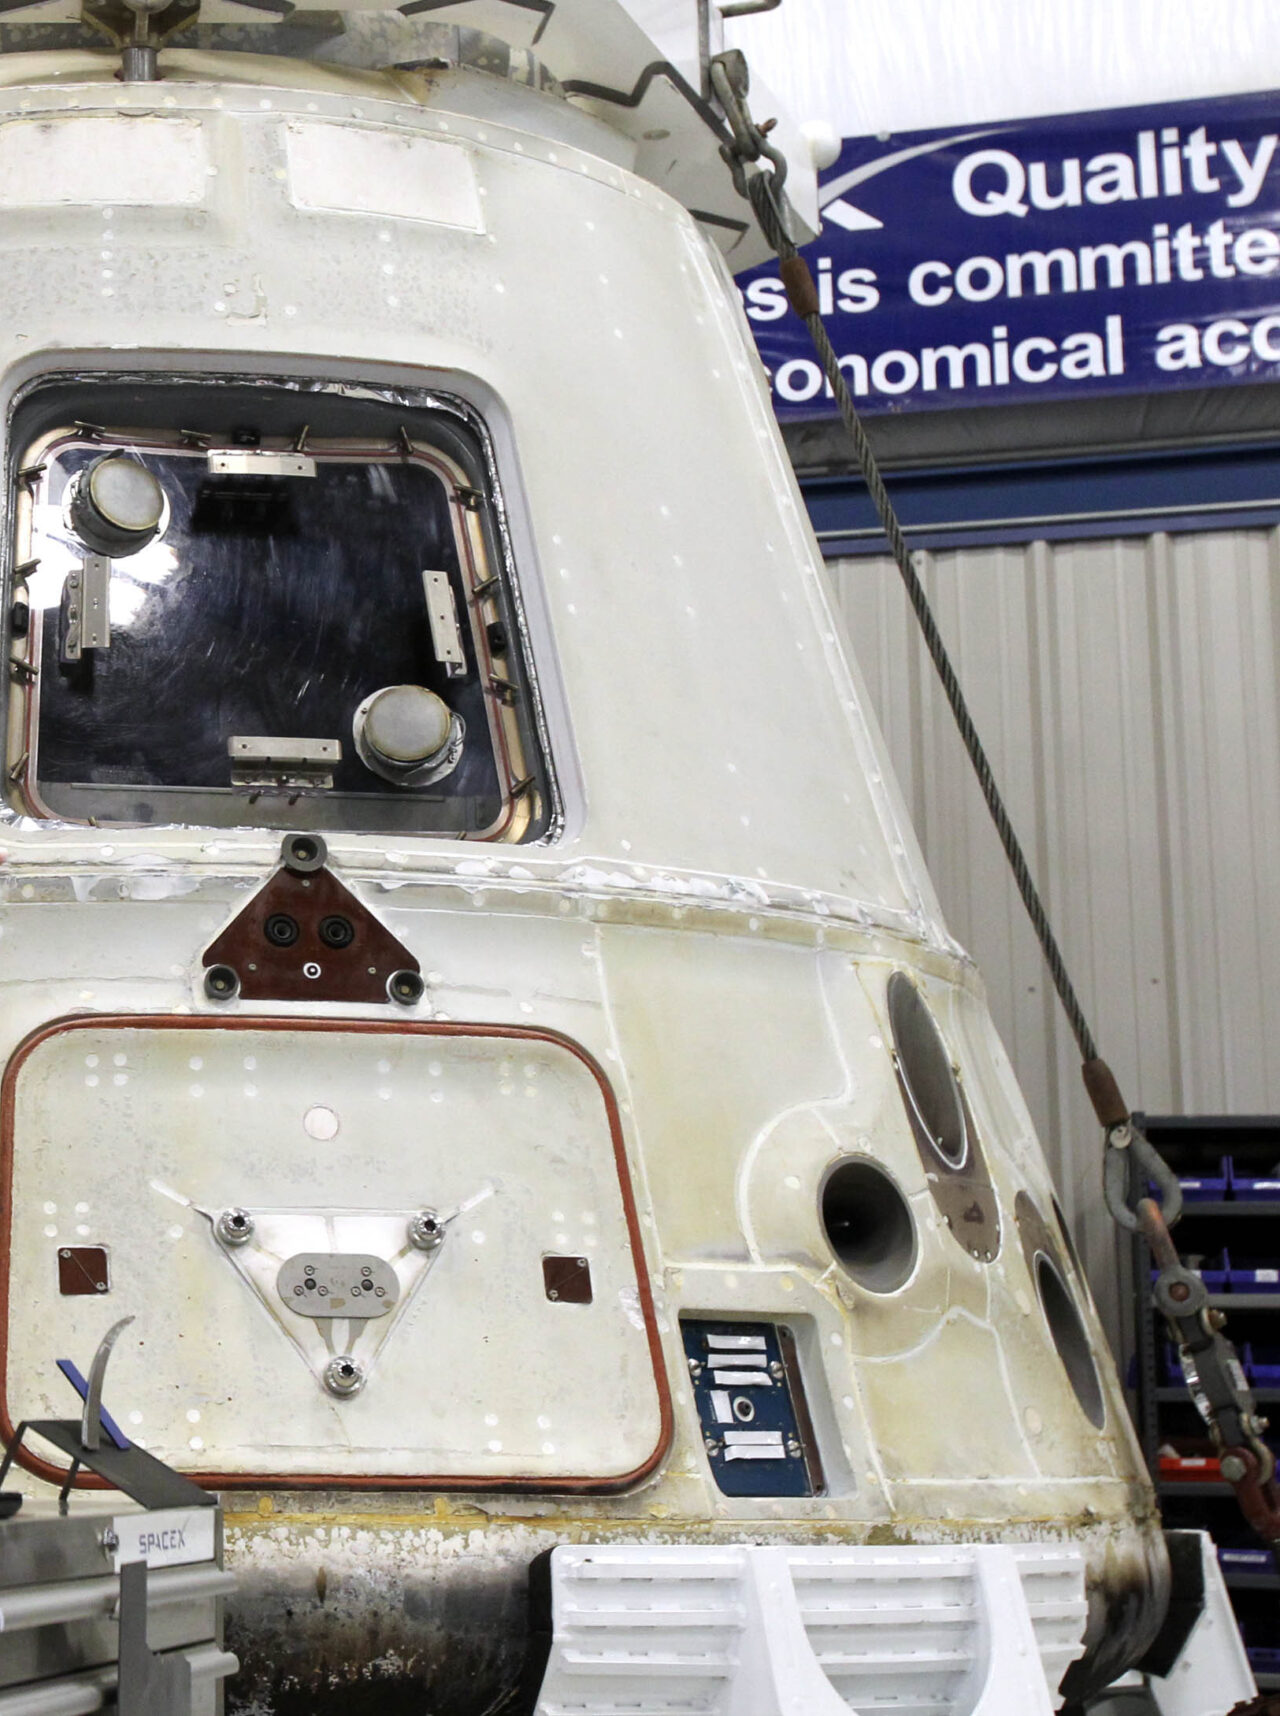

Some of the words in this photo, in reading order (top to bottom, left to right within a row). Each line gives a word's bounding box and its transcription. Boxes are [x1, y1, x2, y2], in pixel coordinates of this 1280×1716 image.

[952, 125, 1279, 218] Quality
[738, 276, 789, 321] s
[817, 257, 880, 316] is
[908, 218, 1280, 306] committe
[763, 314, 1124, 402] onomical
[139, 1529, 186, 1554] SPACEX
